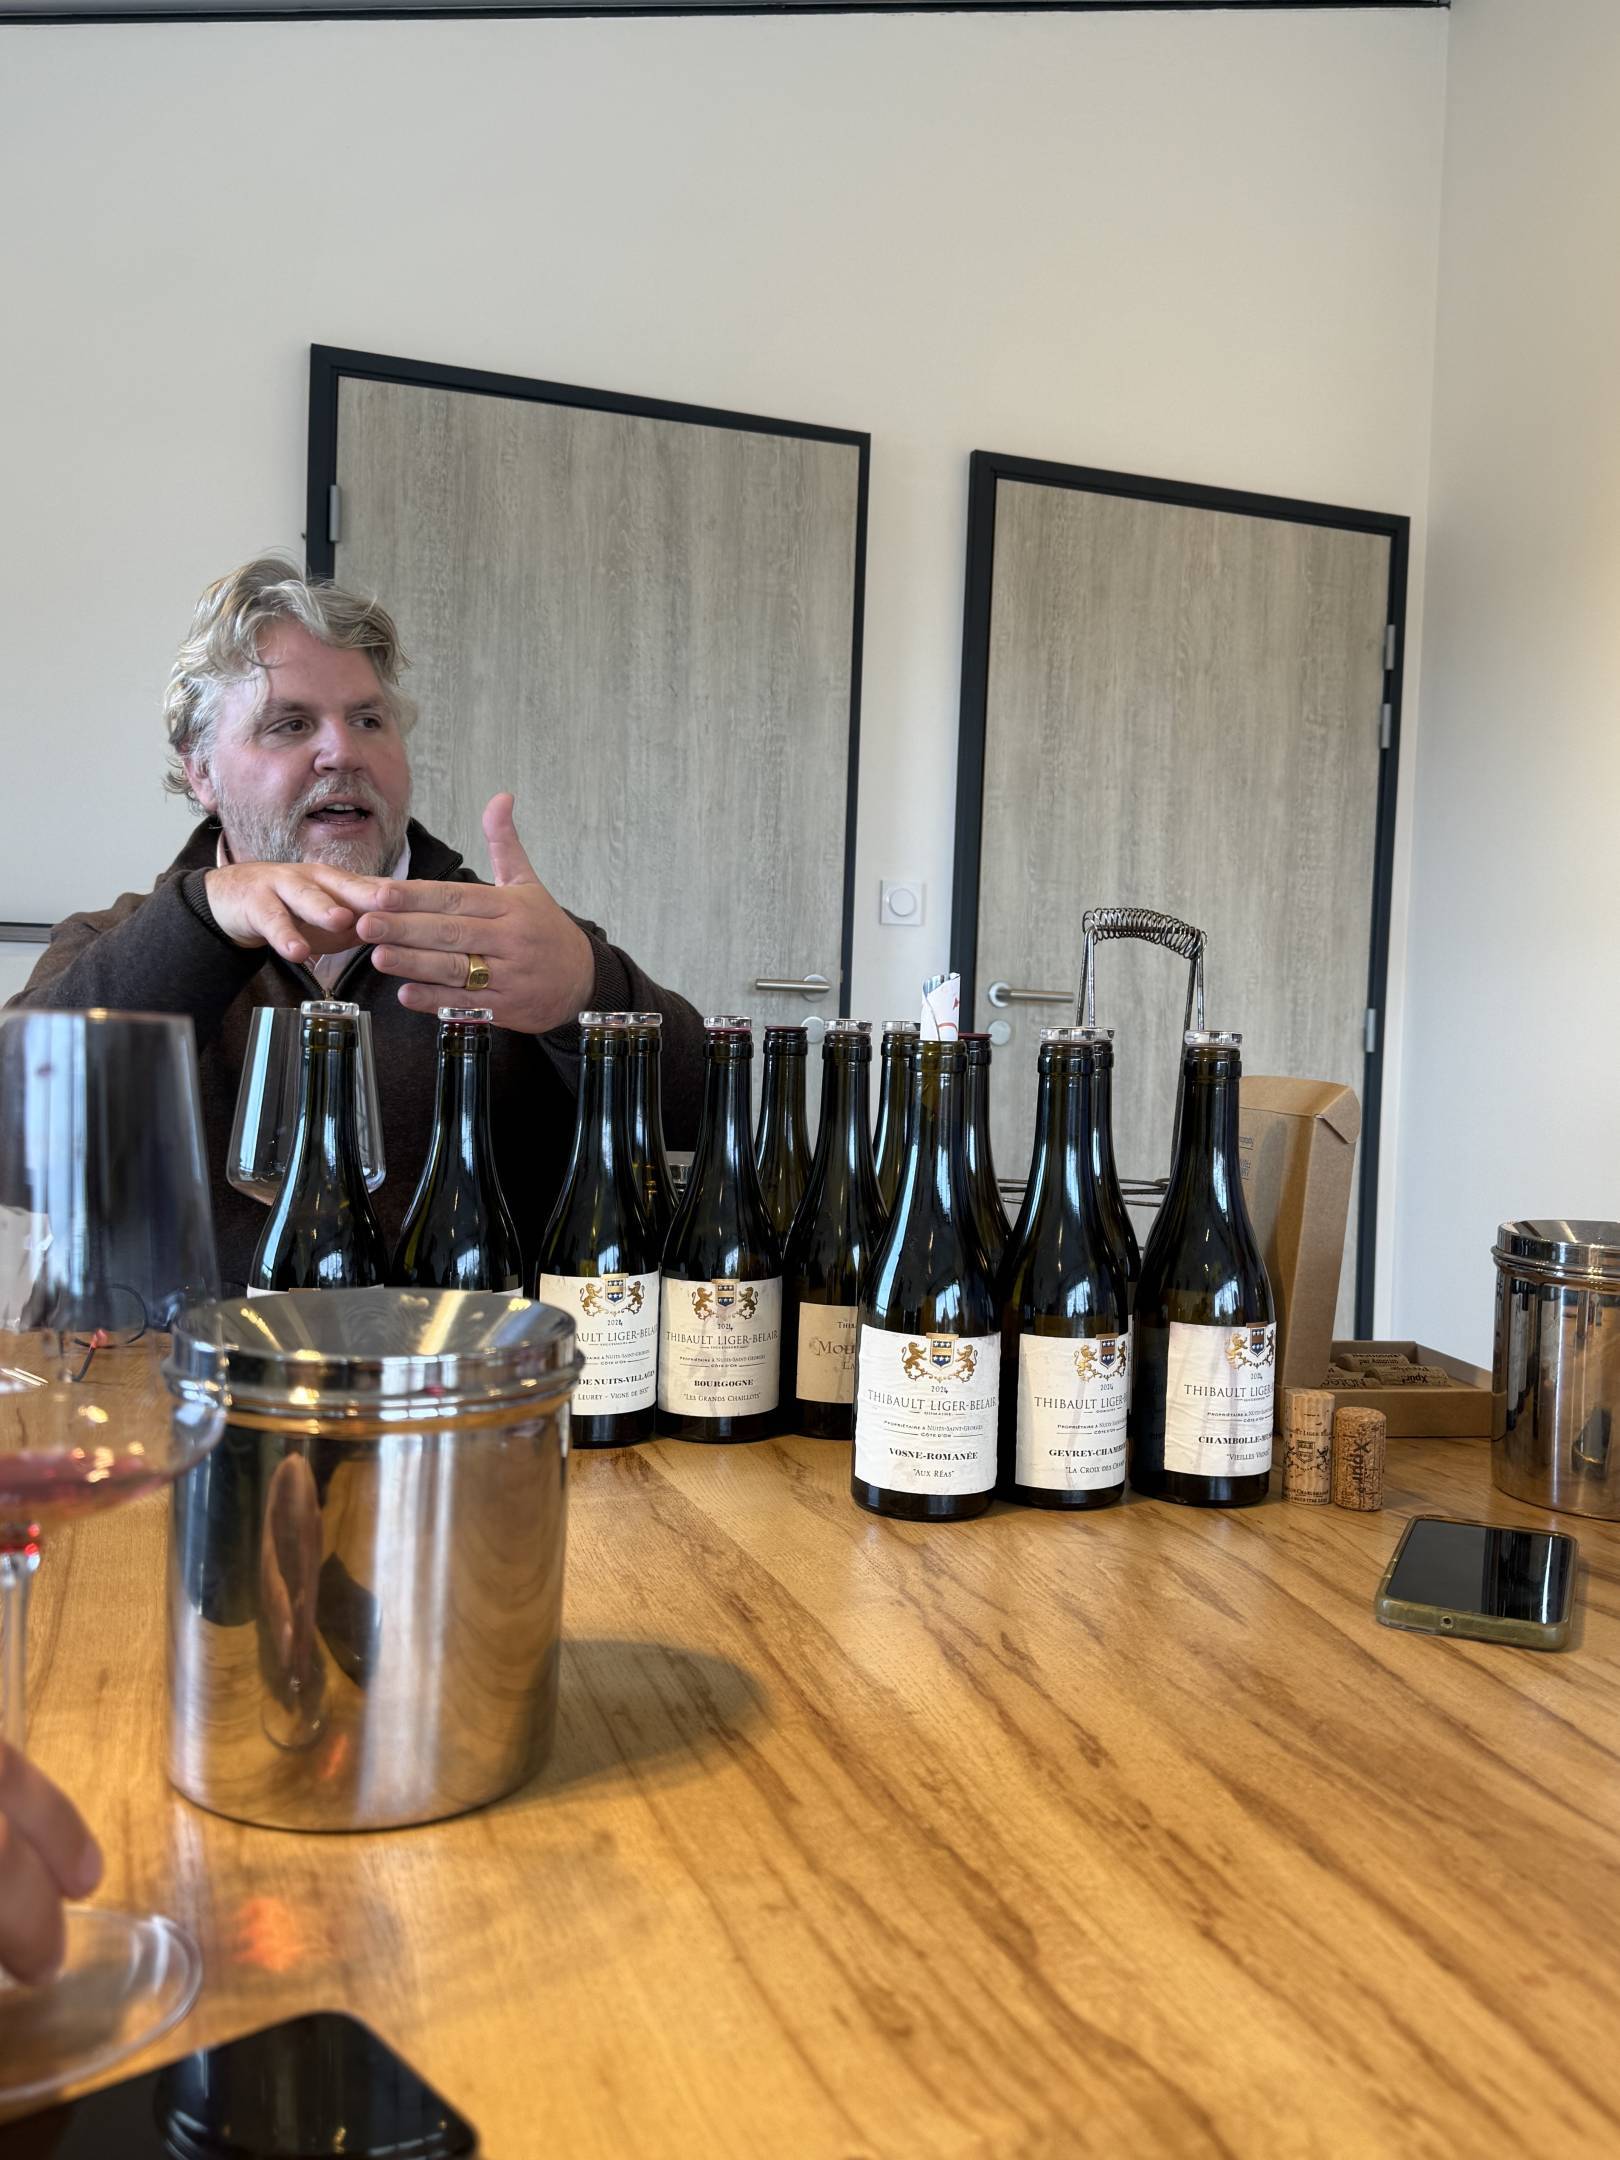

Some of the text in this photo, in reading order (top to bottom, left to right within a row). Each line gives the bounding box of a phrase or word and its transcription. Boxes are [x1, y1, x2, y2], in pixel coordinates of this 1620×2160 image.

[576, 1332, 603, 1343] AULT
[666, 1330, 778, 1345] THIBAULT LIGER-BELAIR
[694, 1379, 753, 1387] BOURGOGNE
[1184, 1384, 1247, 1398] THIBAULT
[867, 1389, 998, 1412] THIBAULT LIGER-BELAIR
[1034, 1396, 1098, 1410] THIBAULT
[889, 1447, 978, 1461] VOSNE-ROMANÉE
[1080, 1466, 1100, 1474] CROIX
